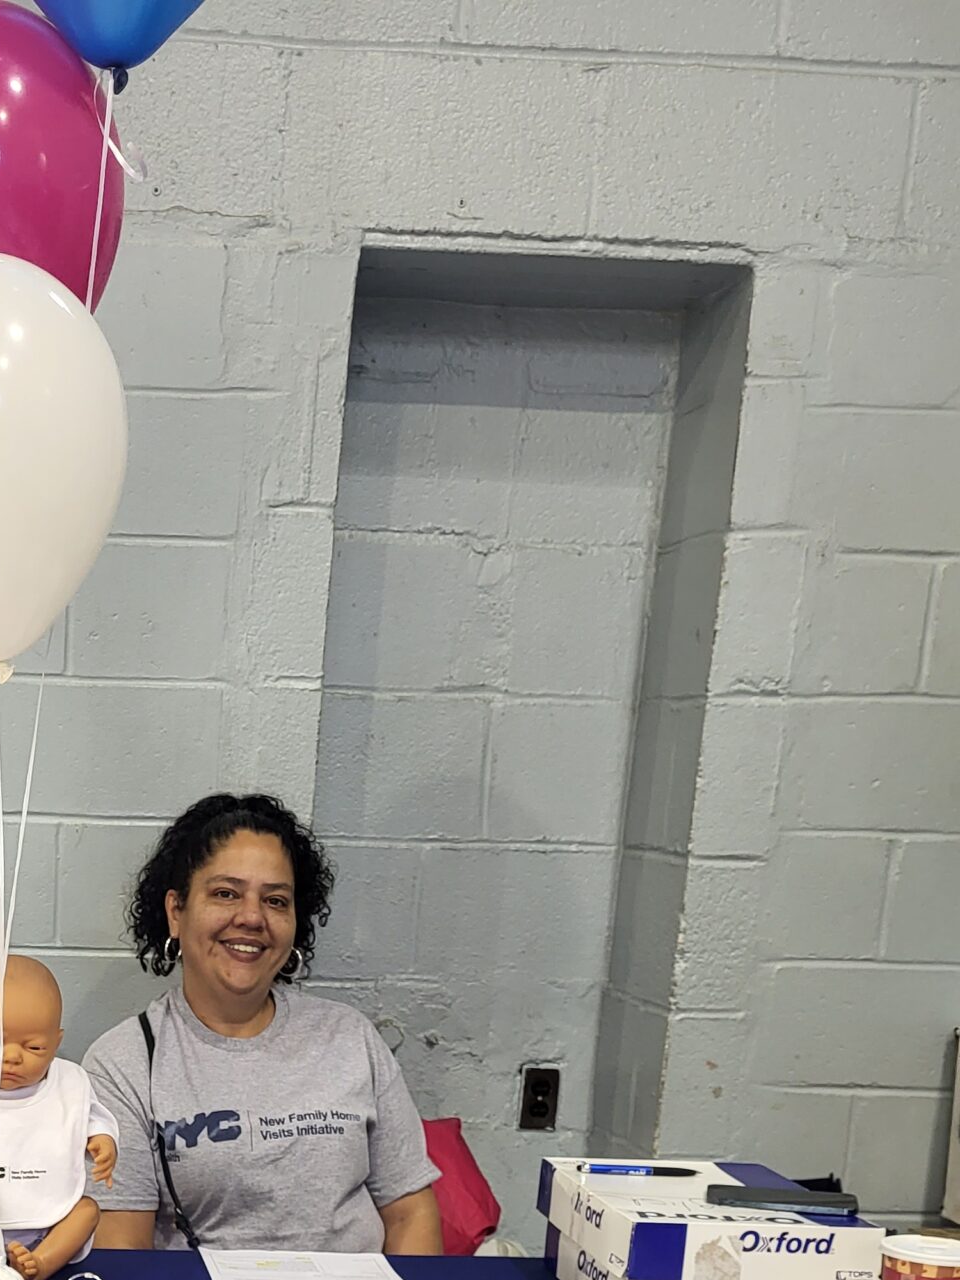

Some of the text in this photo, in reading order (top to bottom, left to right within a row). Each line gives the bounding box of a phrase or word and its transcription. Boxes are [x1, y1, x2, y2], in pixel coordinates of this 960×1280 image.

[259, 1110, 361, 1127] New Family Home
[260, 1124, 345, 1141] Visits Initiative
[739, 1229, 837, 1255] Oxford
[847, 1270, 874, 1279] TOPS
